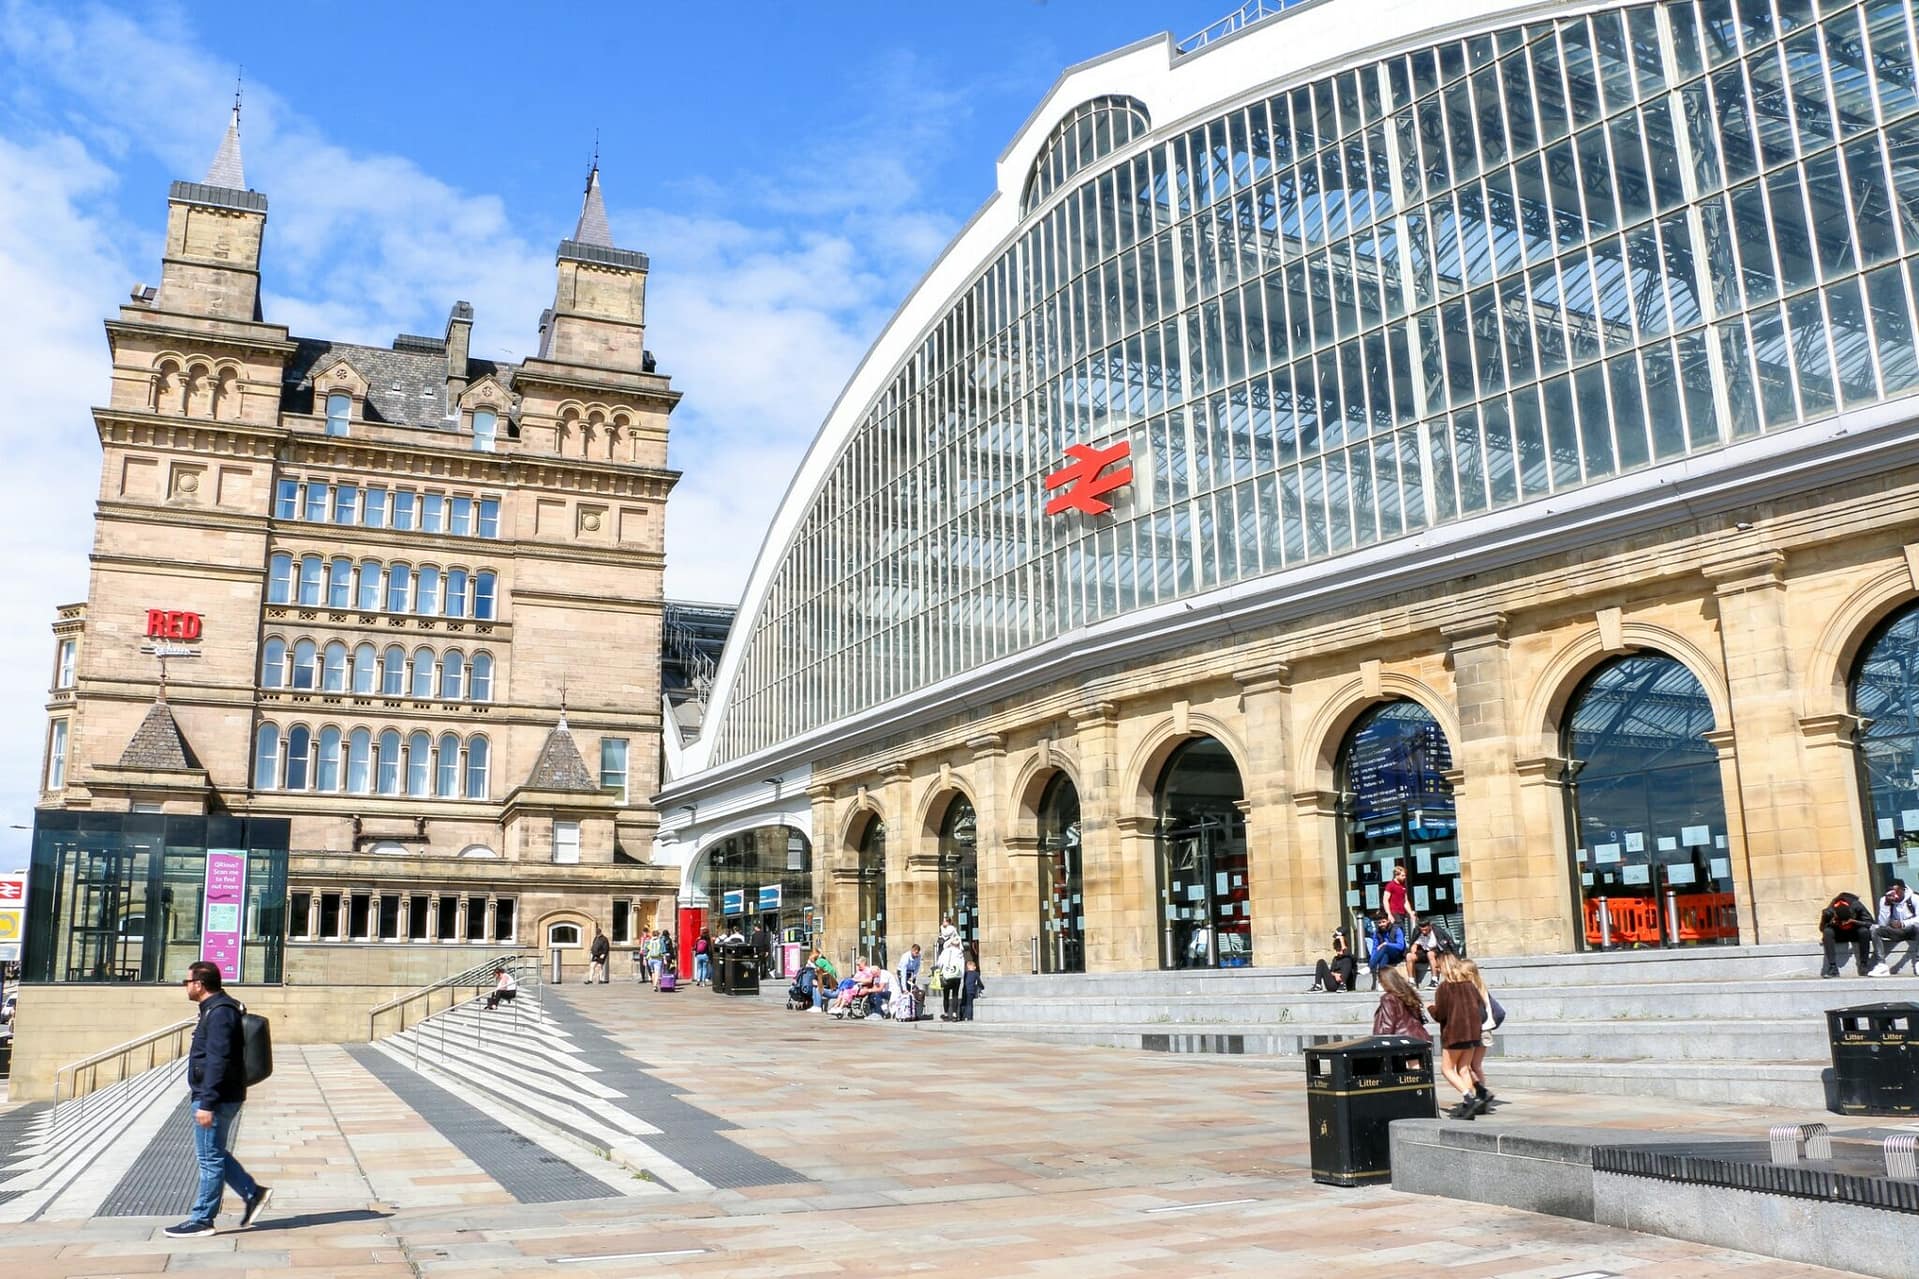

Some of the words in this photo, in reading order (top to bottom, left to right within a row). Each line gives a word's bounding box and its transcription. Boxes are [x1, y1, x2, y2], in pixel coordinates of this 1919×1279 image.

[147, 609, 201, 639] RED
[1843, 1033, 1865, 1041] Litter
[1881, 1032, 1903, 1040] Litter
[1359, 1078, 1380, 1088] Litter
[1399, 1075, 1420, 1084] Litter
